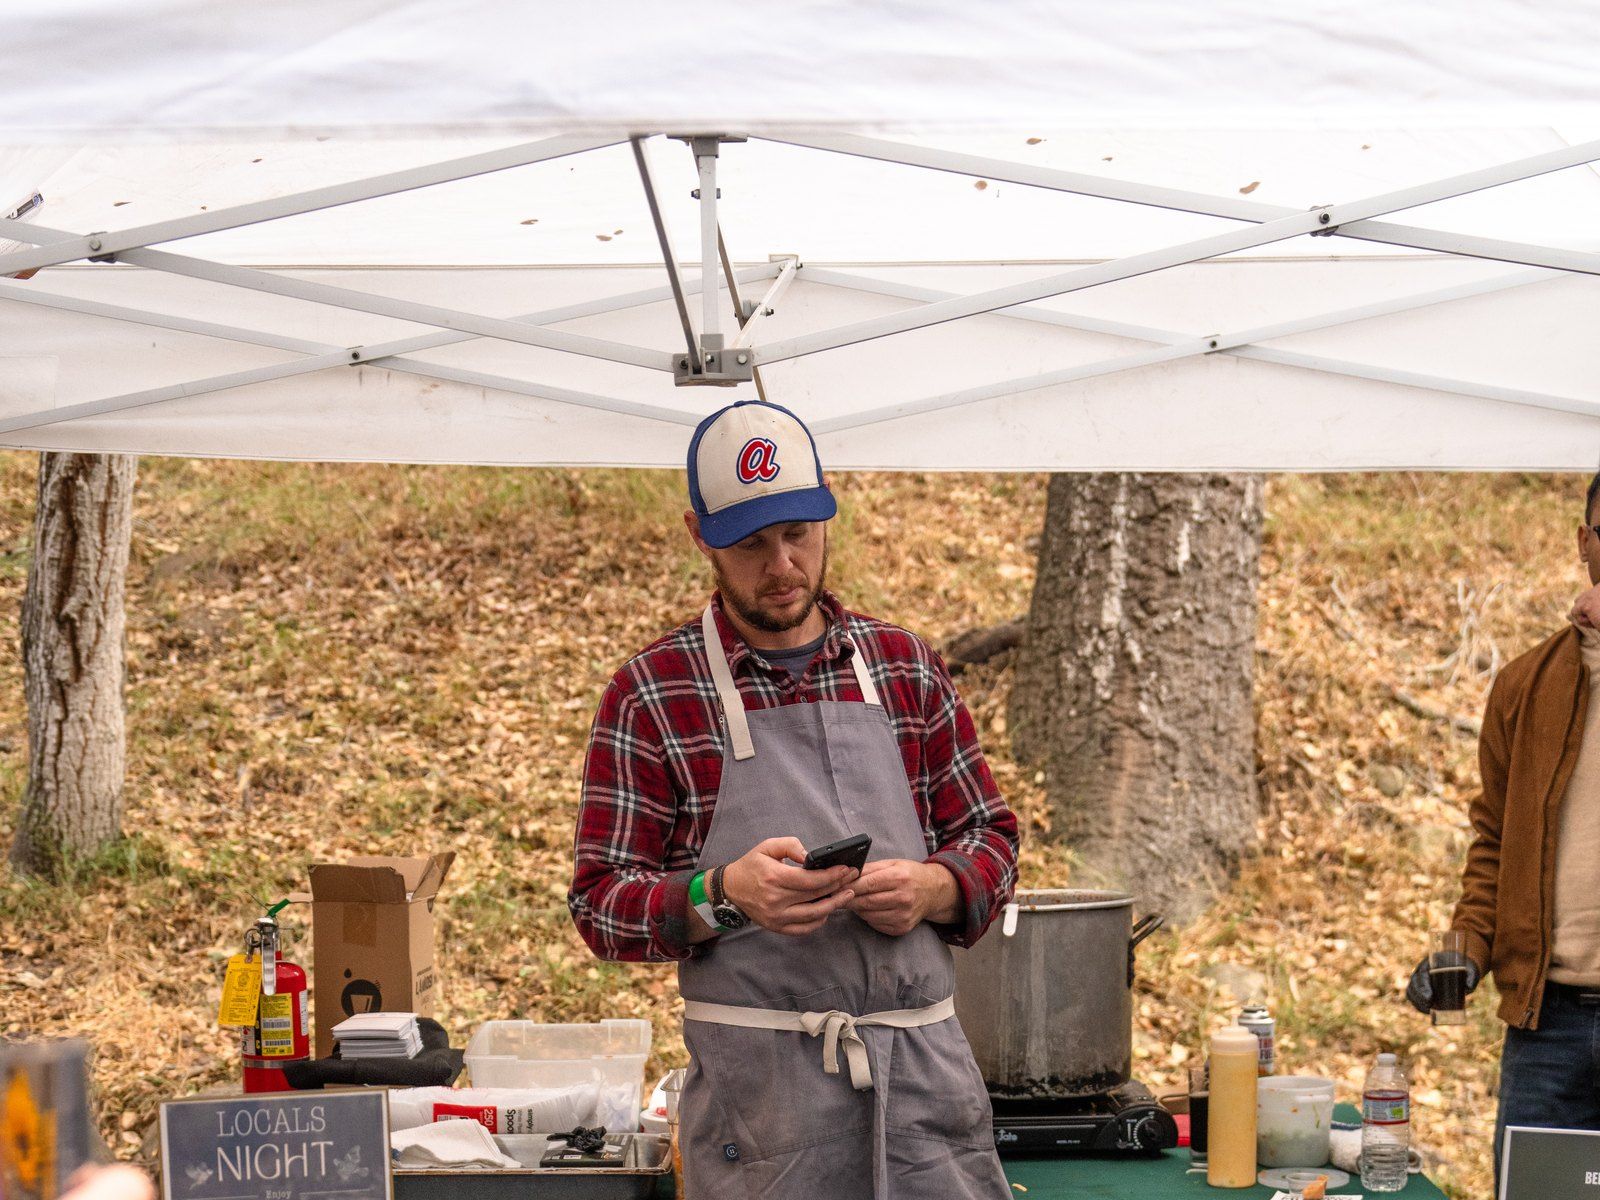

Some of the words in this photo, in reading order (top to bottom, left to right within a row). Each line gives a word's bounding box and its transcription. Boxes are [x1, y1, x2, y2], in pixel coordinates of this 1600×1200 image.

[217, 1106, 326, 1136] LOCALS
[483, 1108, 494, 1126] 250
[217, 1141, 334, 1181] NIGHT
[266, 1190, 292, 1200] Enjoy
